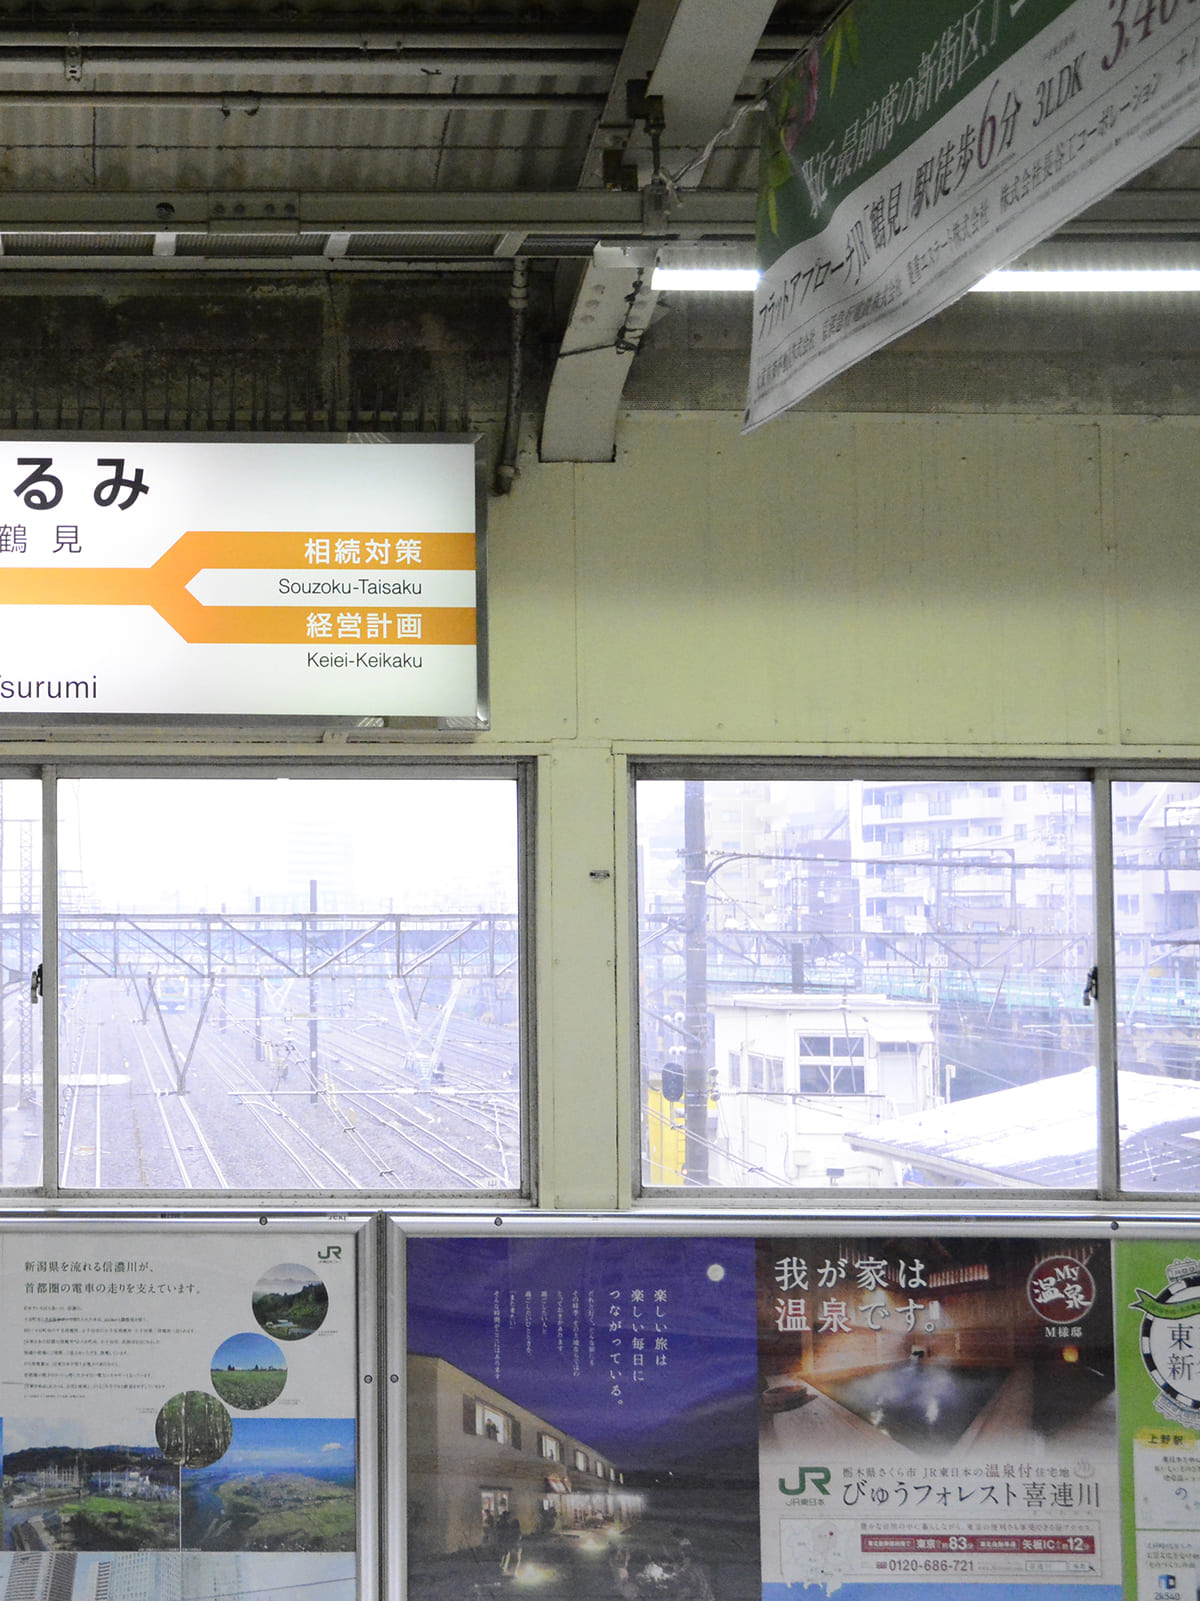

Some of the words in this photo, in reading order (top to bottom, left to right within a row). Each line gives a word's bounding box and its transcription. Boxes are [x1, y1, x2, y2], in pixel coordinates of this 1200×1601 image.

[304, 537, 422, 565] 相続対策
[278, 577, 422, 595] Souzoku-Taisaku
[306, 611, 422, 640] 経営計画
[307, 651, 422, 668] Keiei-Keikaku
[317, 1245, 342, 1260] JR
[774, 1256, 928, 1292] 我が家は
[654, 1288, 668, 1367] 楽しい旅は
[774, 1297, 936, 1335] 温泉です。
[609, 1289, 624, 1405] つながっている。
[631, 1288, 645, 1382] 楽しい毎日に
[1167, 1323, 1200, 1350] 東
[1167, 1354, 1200, 1380] 新
[778, 1466, 831, 1496] JR
[842, 1479, 1101, 1508] びゅうフォレスト喜連川
[888, 1560, 974, 1572] 0120-686-721
